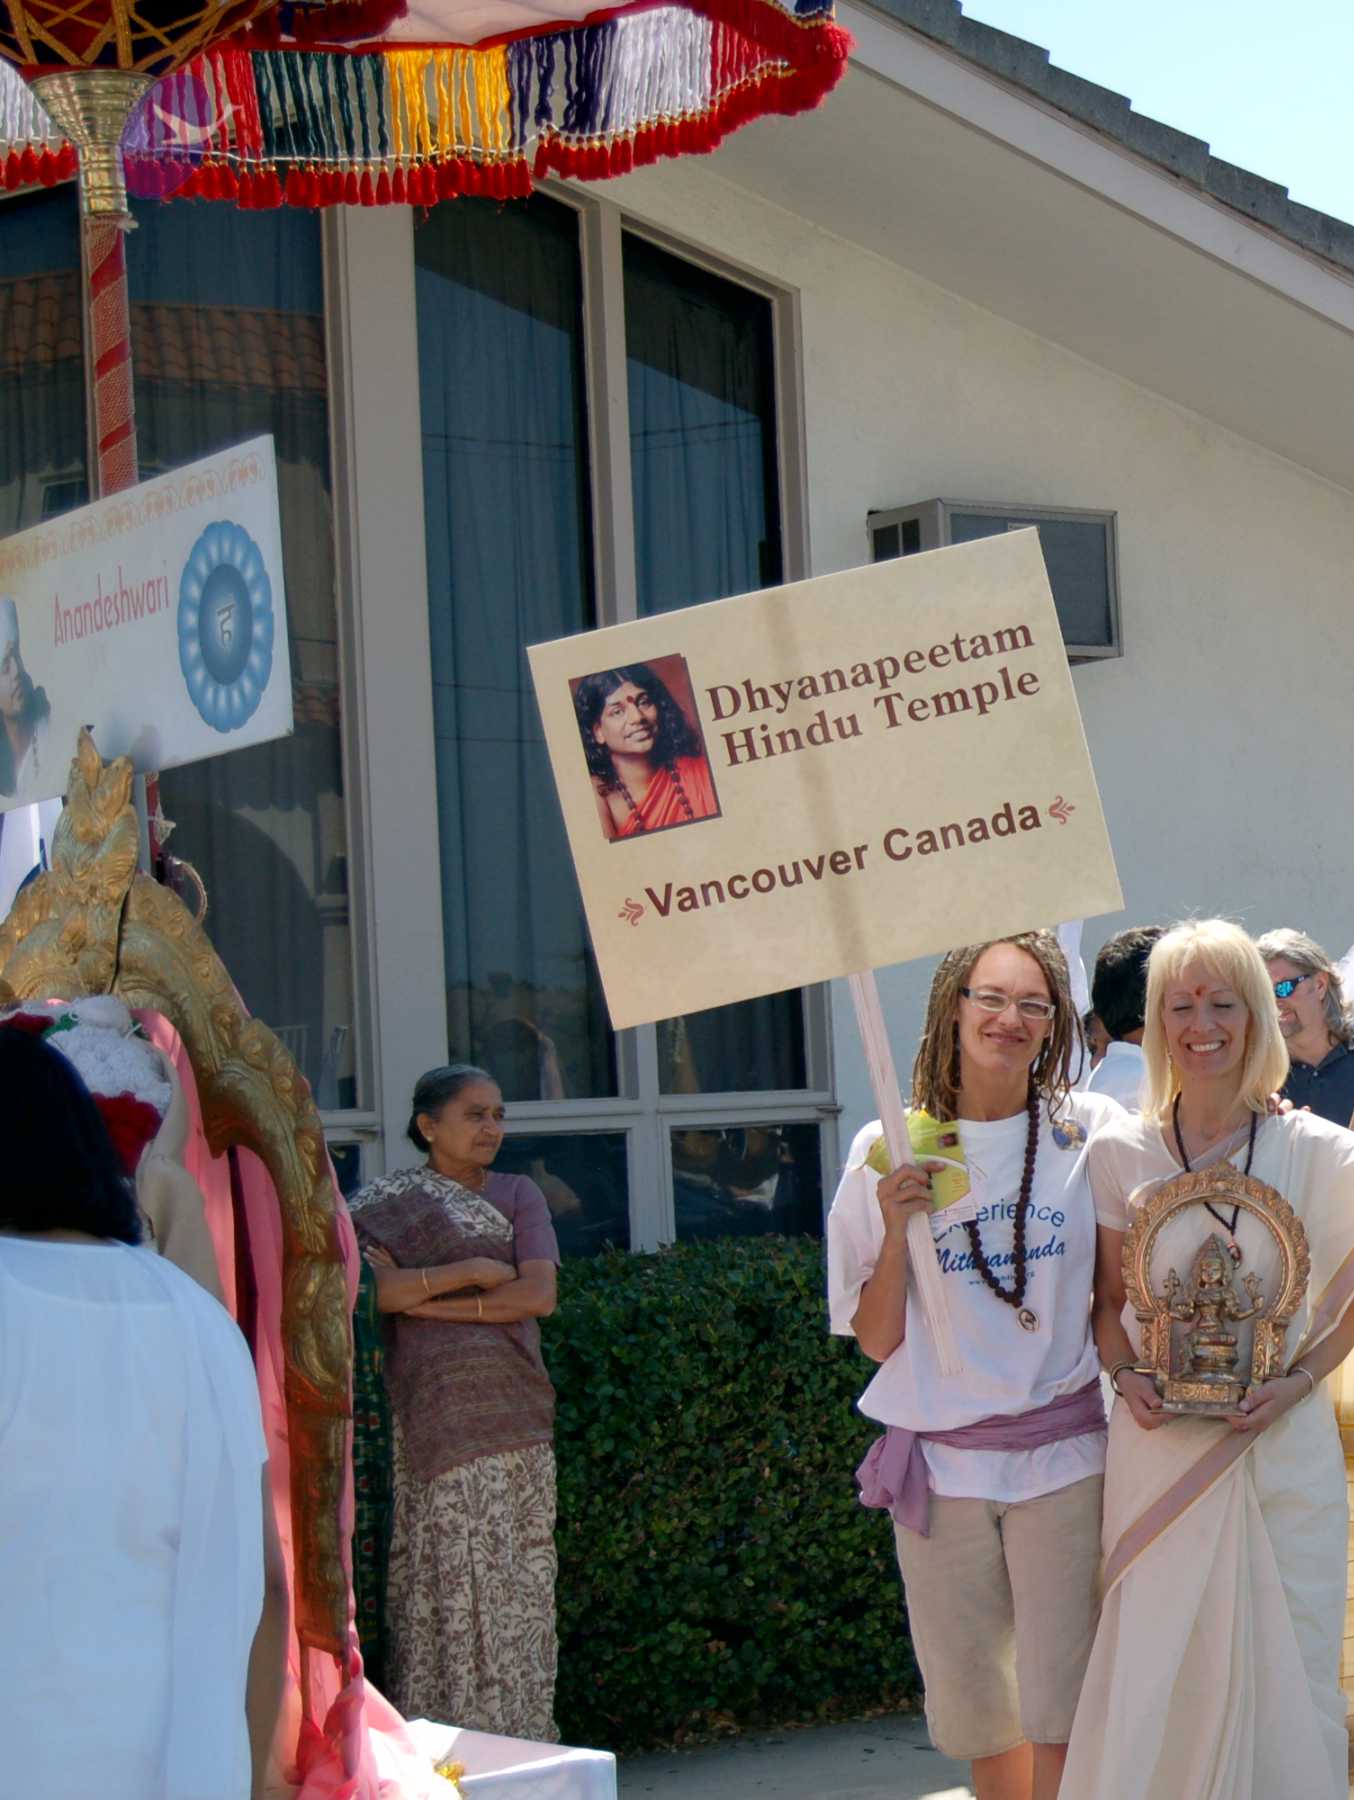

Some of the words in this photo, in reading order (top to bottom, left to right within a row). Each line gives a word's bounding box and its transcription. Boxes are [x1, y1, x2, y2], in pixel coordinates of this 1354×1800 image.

[54, 560, 169, 647] Anandeshwari
[705, 623, 1036, 722] Dhyanapeetam
[720, 710, 863, 767] Hindu
[874, 666, 1041, 729] Temple
[645, 846, 868, 918] Vancouver
[884, 802, 1042, 861] Canada
[933, 1198, 1066, 1243] erience
